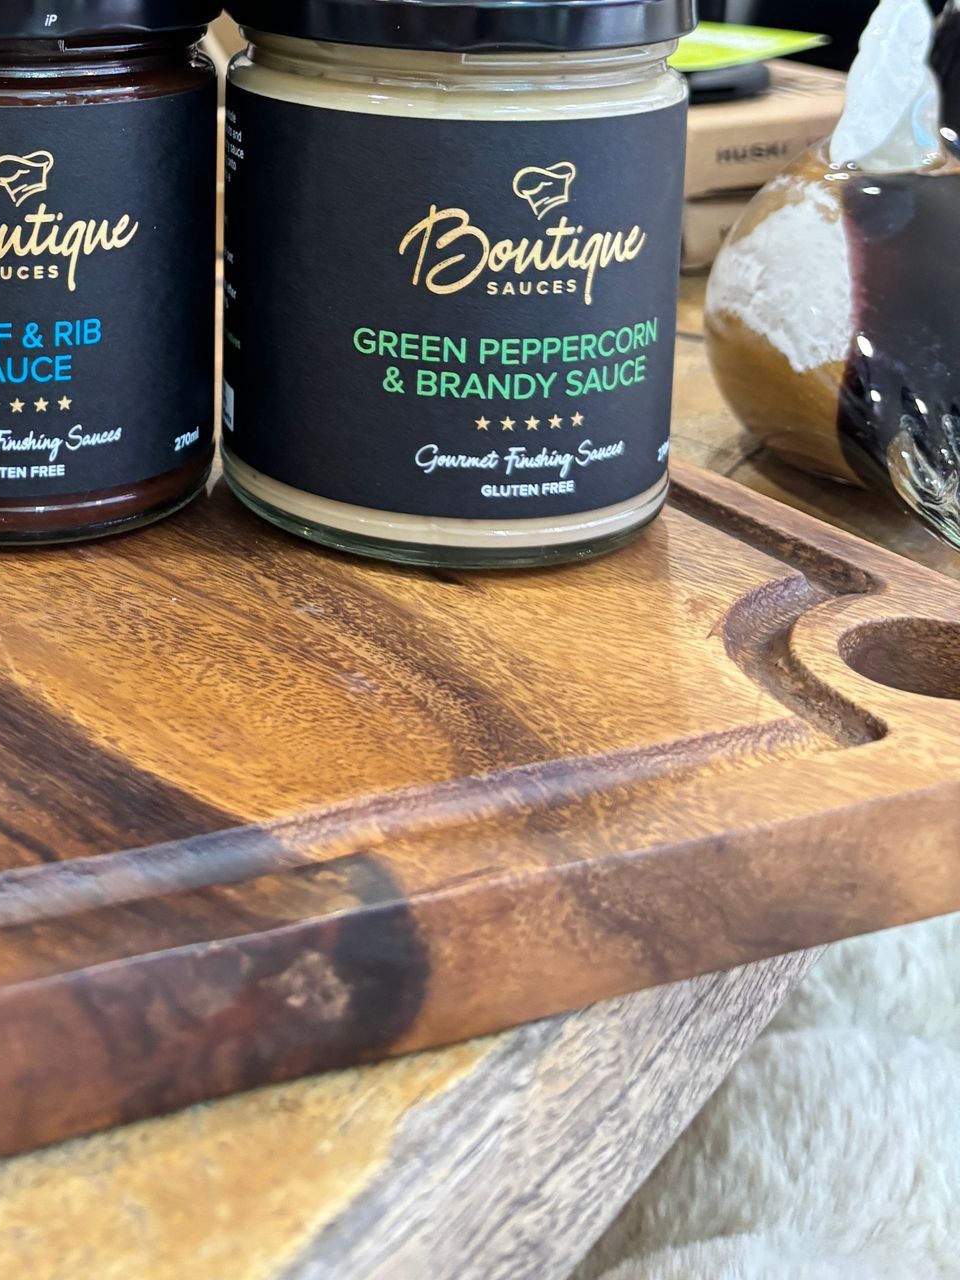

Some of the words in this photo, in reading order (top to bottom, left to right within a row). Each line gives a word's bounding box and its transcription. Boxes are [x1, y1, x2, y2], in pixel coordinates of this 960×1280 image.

[715, 140, 788, 163] HUSKI
[399, 204, 645, 305] Boutique
[487, 279, 576, 295] SAUCES
[22, 323, 43, 348] &
[55, 319, 101, 346] RIB
[354, 328, 466, 363] GREEN
[480, 317, 657, 365] PEPPERCORN
[383, 367, 404, 393] &
[417, 370, 557, 399] BRANDY
[565, 354, 645, 396] SAUCE
[65, 424, 121, 450] Sauces
[175, 427, 198, 451] 270ml
[31, 465, 65, 477] FREE
[415, 444, 499, 473] Gourmet
[504, 447, 573, 478] Finishing
[575, 439, 624, 466] Sauces
[481, 484, 539, 497] GLUTEN
[542, 480, 574, 495] FREE
